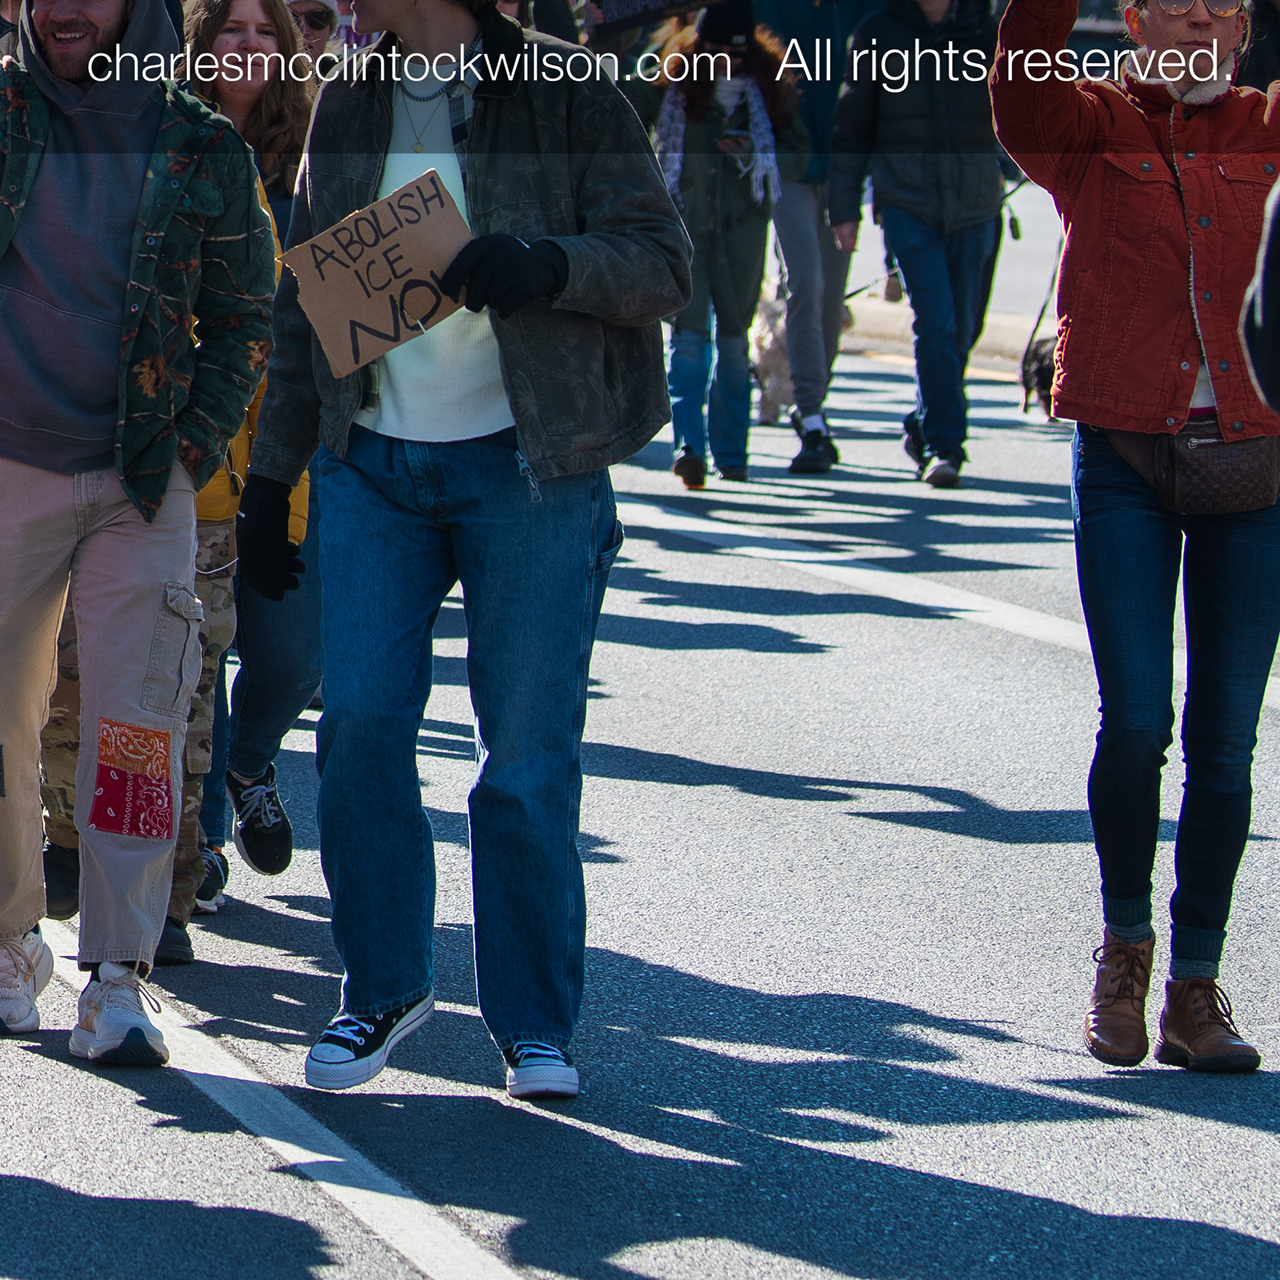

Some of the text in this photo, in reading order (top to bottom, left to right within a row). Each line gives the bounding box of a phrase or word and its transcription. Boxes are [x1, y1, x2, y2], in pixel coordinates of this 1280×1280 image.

[309, 175, 446, 282] ABOLISH
[354, 242, 414, 300] ICE
[348, 269, 452, 366] NO
